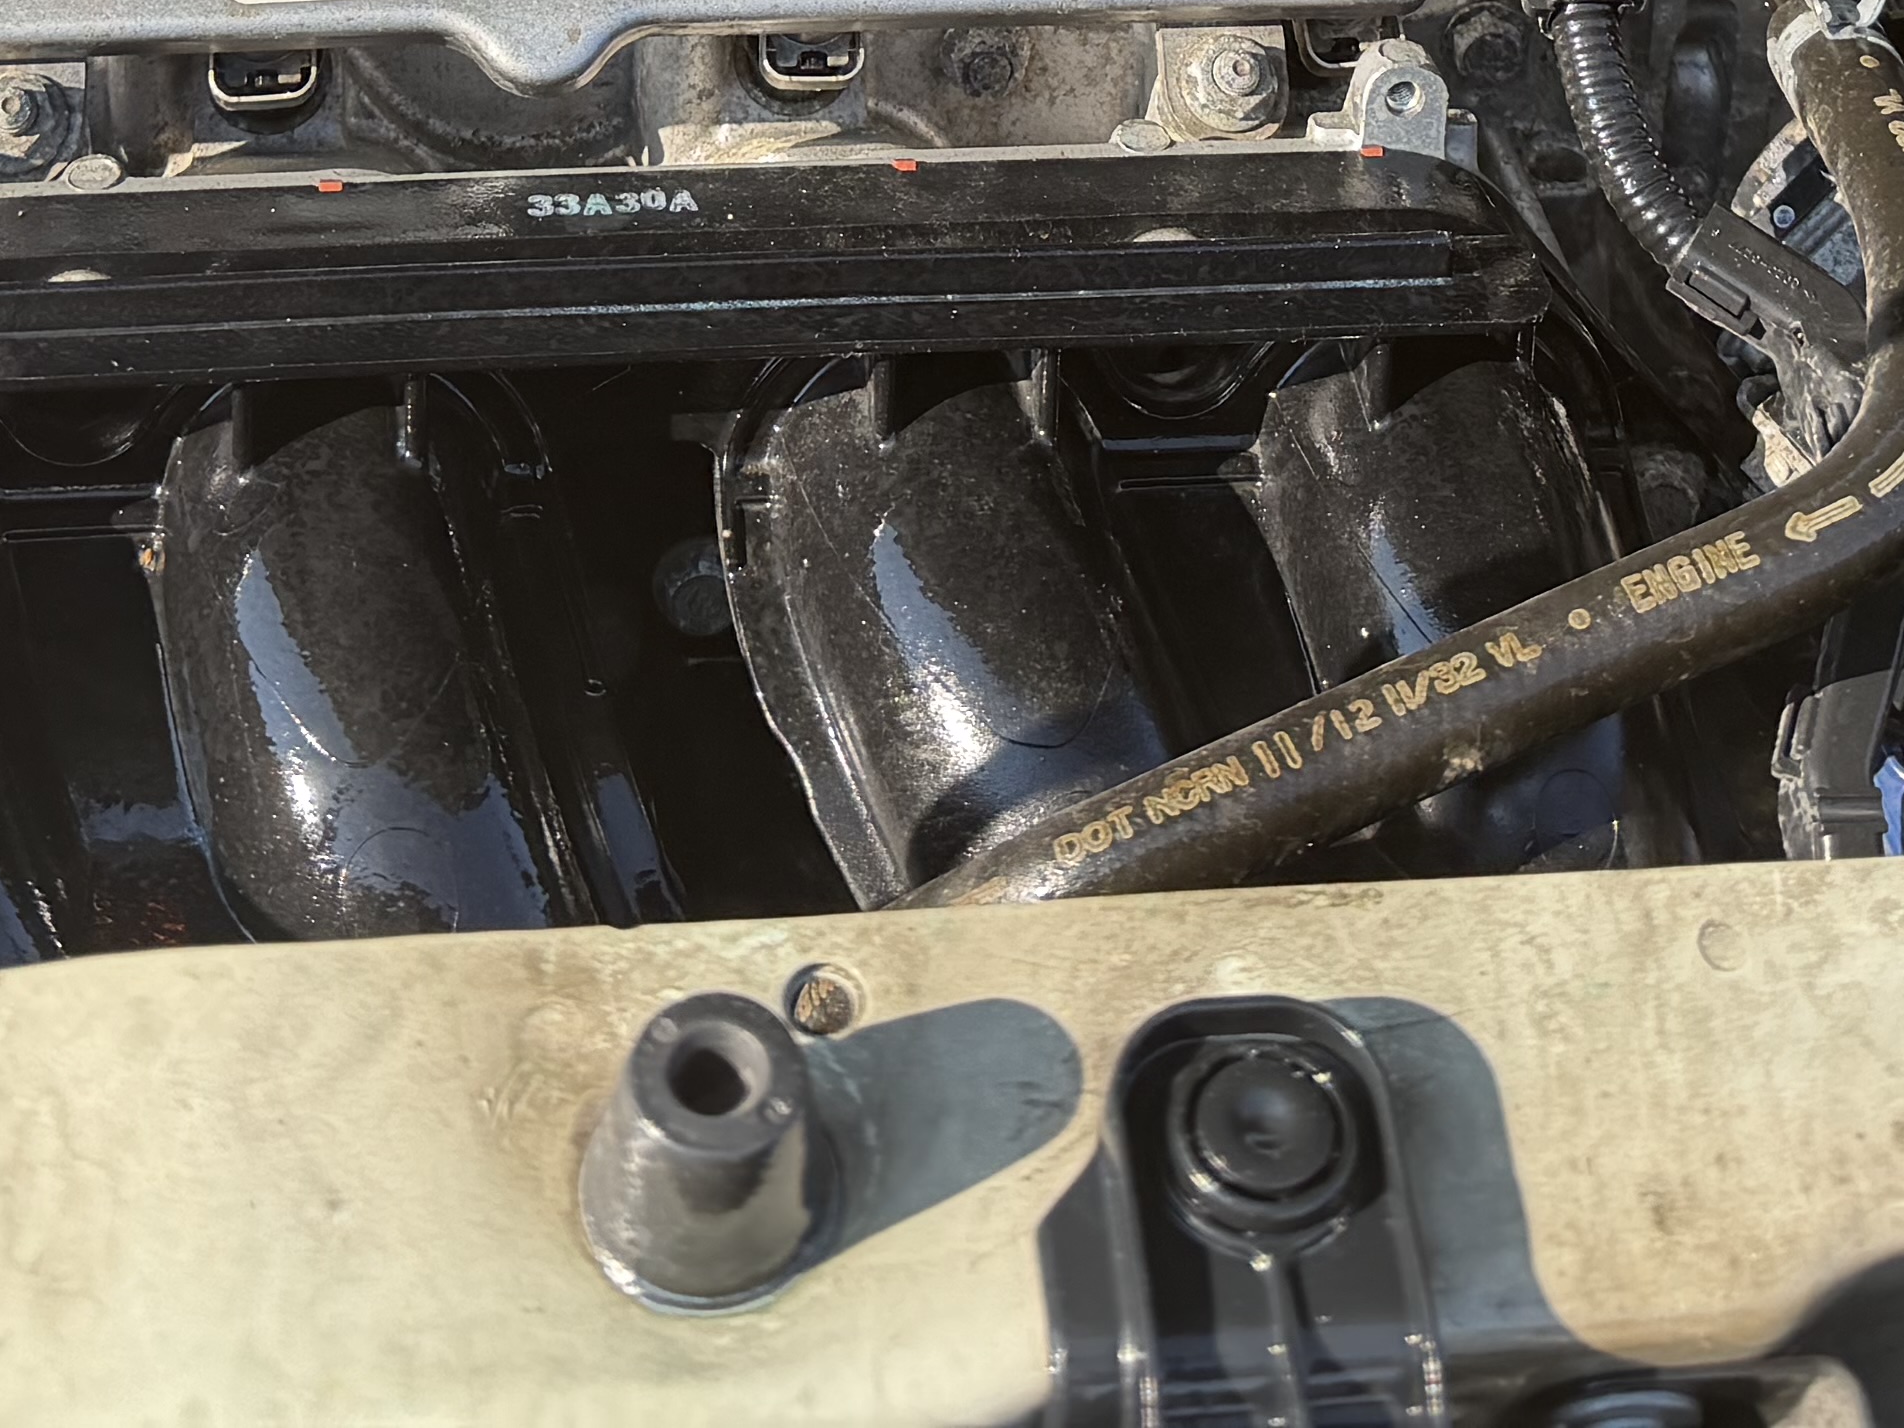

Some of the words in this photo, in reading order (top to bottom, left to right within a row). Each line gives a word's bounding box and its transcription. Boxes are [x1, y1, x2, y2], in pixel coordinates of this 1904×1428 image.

[526, 188, 700, 218] 33A30A
[1053, 804, 1133, 866] DOT
[1381, 650, 1487, 717] 11/32
[1485, 631, 1543, 668] VL
[1620, 529, 1761, 614] ENGINE
